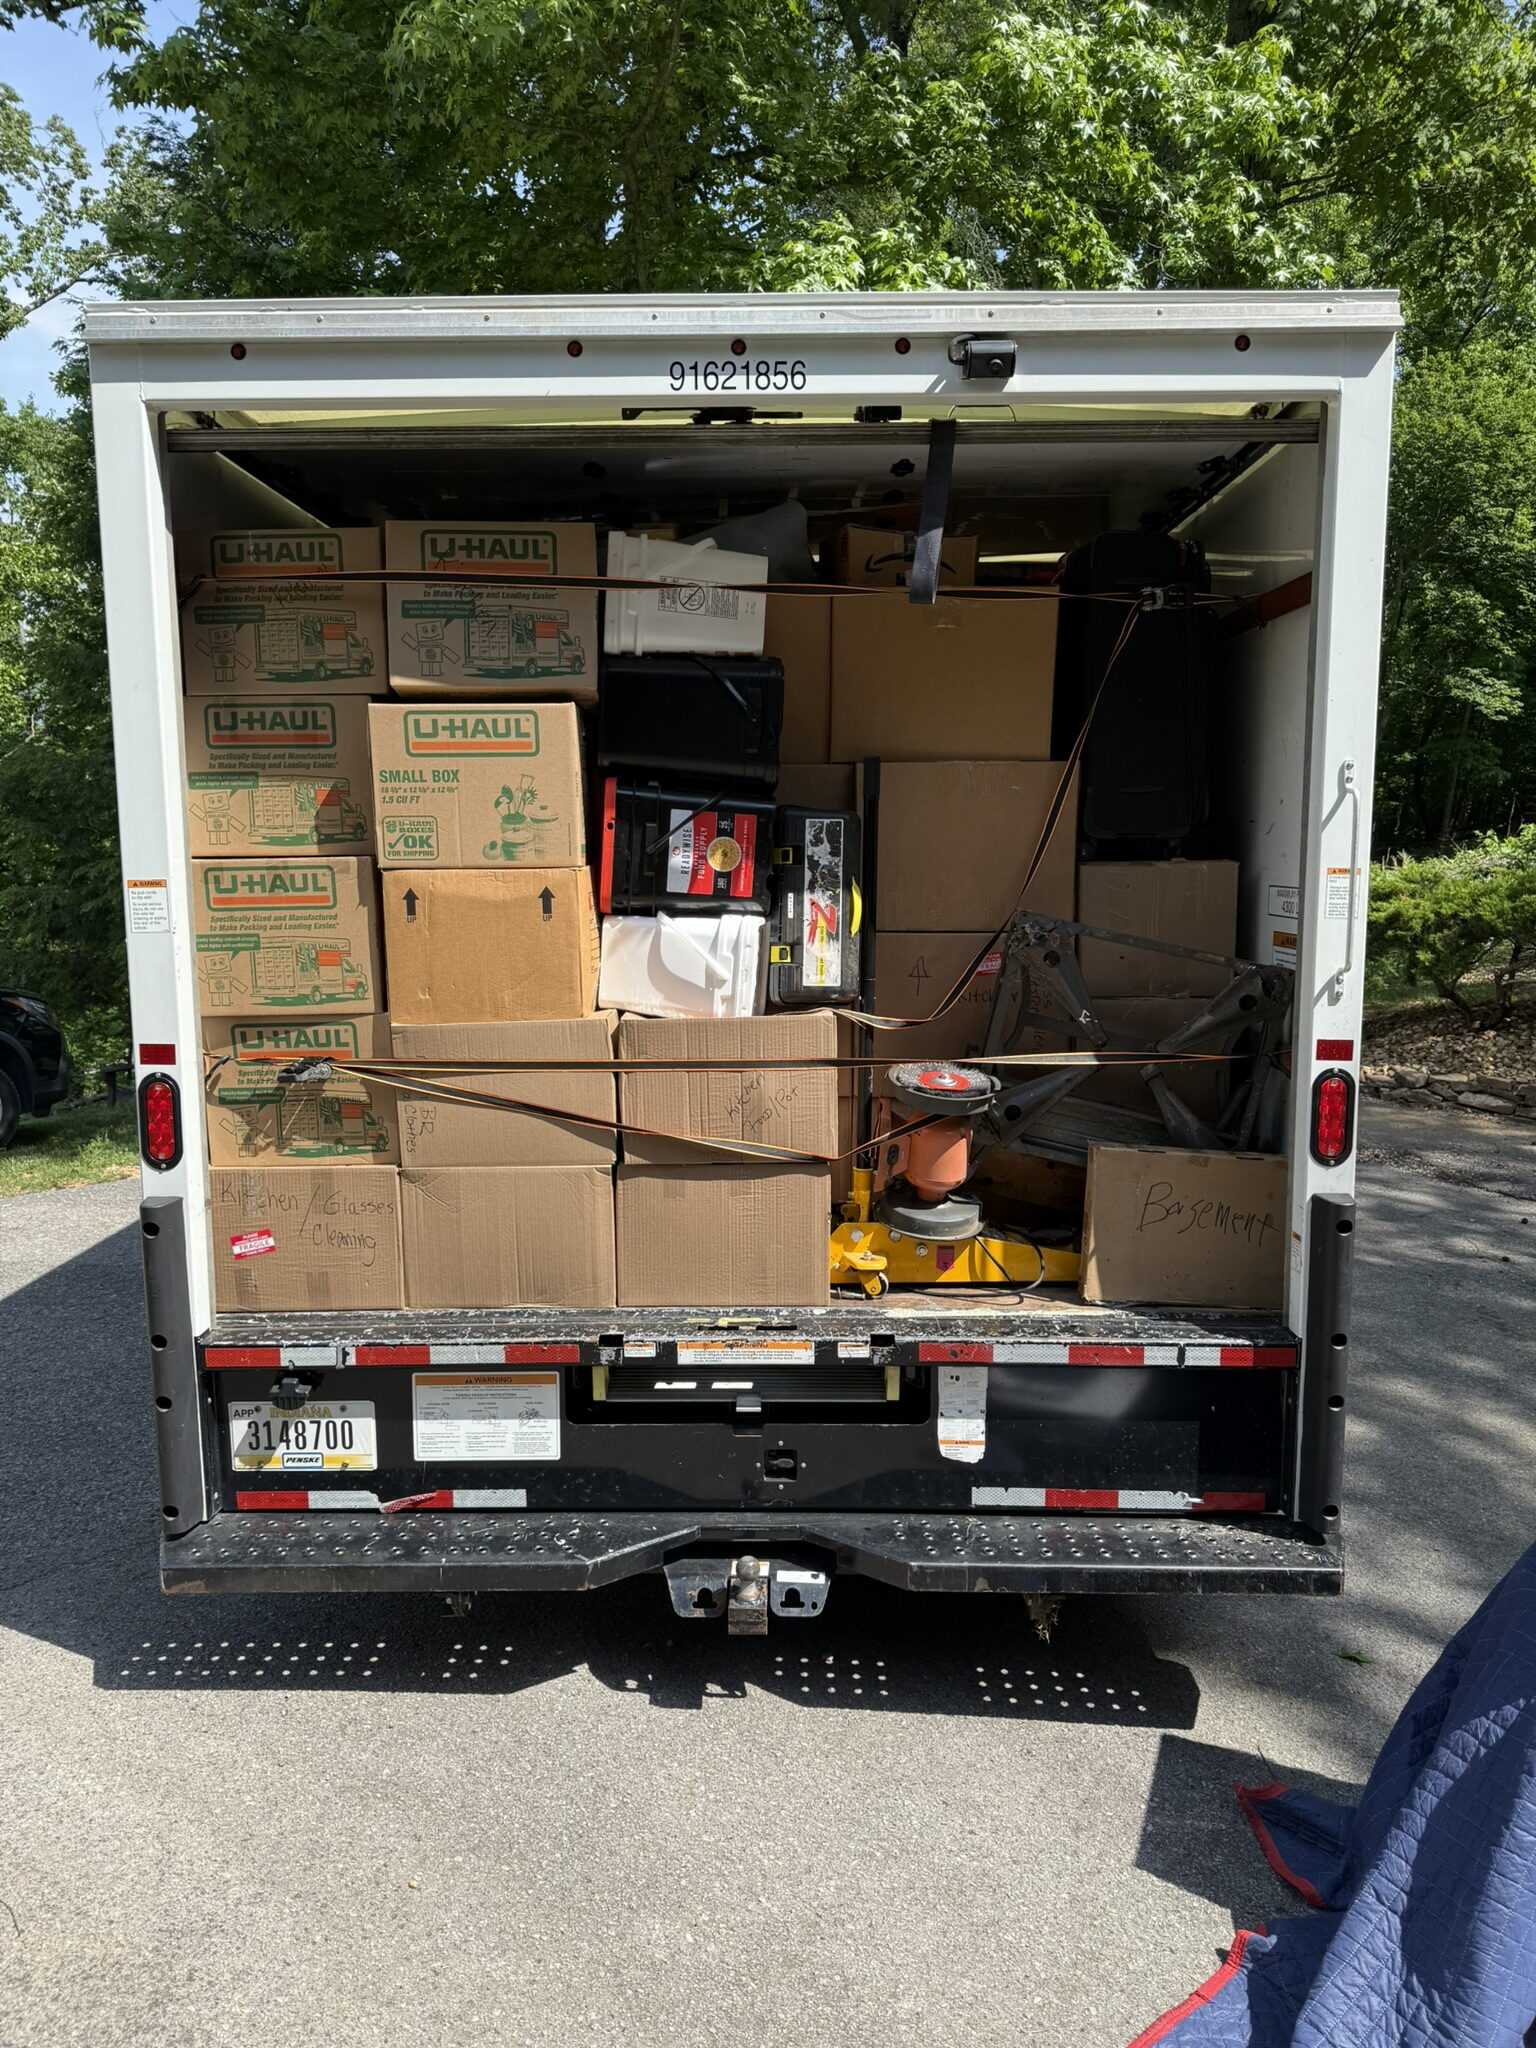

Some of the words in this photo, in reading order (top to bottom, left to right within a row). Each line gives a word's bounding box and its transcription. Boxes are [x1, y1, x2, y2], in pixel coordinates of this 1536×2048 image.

[669, 359, 807, 392] 91621856
[219, 542, 334, 563] U-HAUL
[430, 537, 548, 560] U-HAUL
[213, 710, 328, 731] U-HAUL
[413, 717, 531, 739] U-HAUL
[210, 753, 250, 761] Specifically
[252, 752, 270, 760] Sized
[272, 752, 286, 760] and
[379, 769, 427, 783] SMALL
[432, 769, 460, 783] BOX
[382, 796, 394, 804] 1.5
[396, 796, 407, 804] CU
[410, 796, 420, 804] FT
[403, 835, 433, 849] OK
[699, 827, 708, 856] SUPPLY
[681, 829, 692, 875] READYWISE
[697, 859, 706, 879] FOOD
[213, 873, 328, 894] U-HAUL
[210, 916, 250, 924] Specifically
[252, 914, 272, 922] Sized
[273, 914, 286, 922] and
[288, 913, 338, 921] Manufactured
[240, 924, 268, 932] Packing
[407, 916, 416, 924] UP
[543, 914, 553, 922] UP
[239, 1029, 350, 1049] U-HAUL
[1136, 1181, 1281, 1248] Basement
[239, 1239, 270, 1251] FRAGILE
[312, 1224, 377, 1267] Cleaning
[474, 1376, 512, 1384] WARNING
[233, 1409, 254, 1418] APP
[247, 1420, 354, 1451] 3148700
